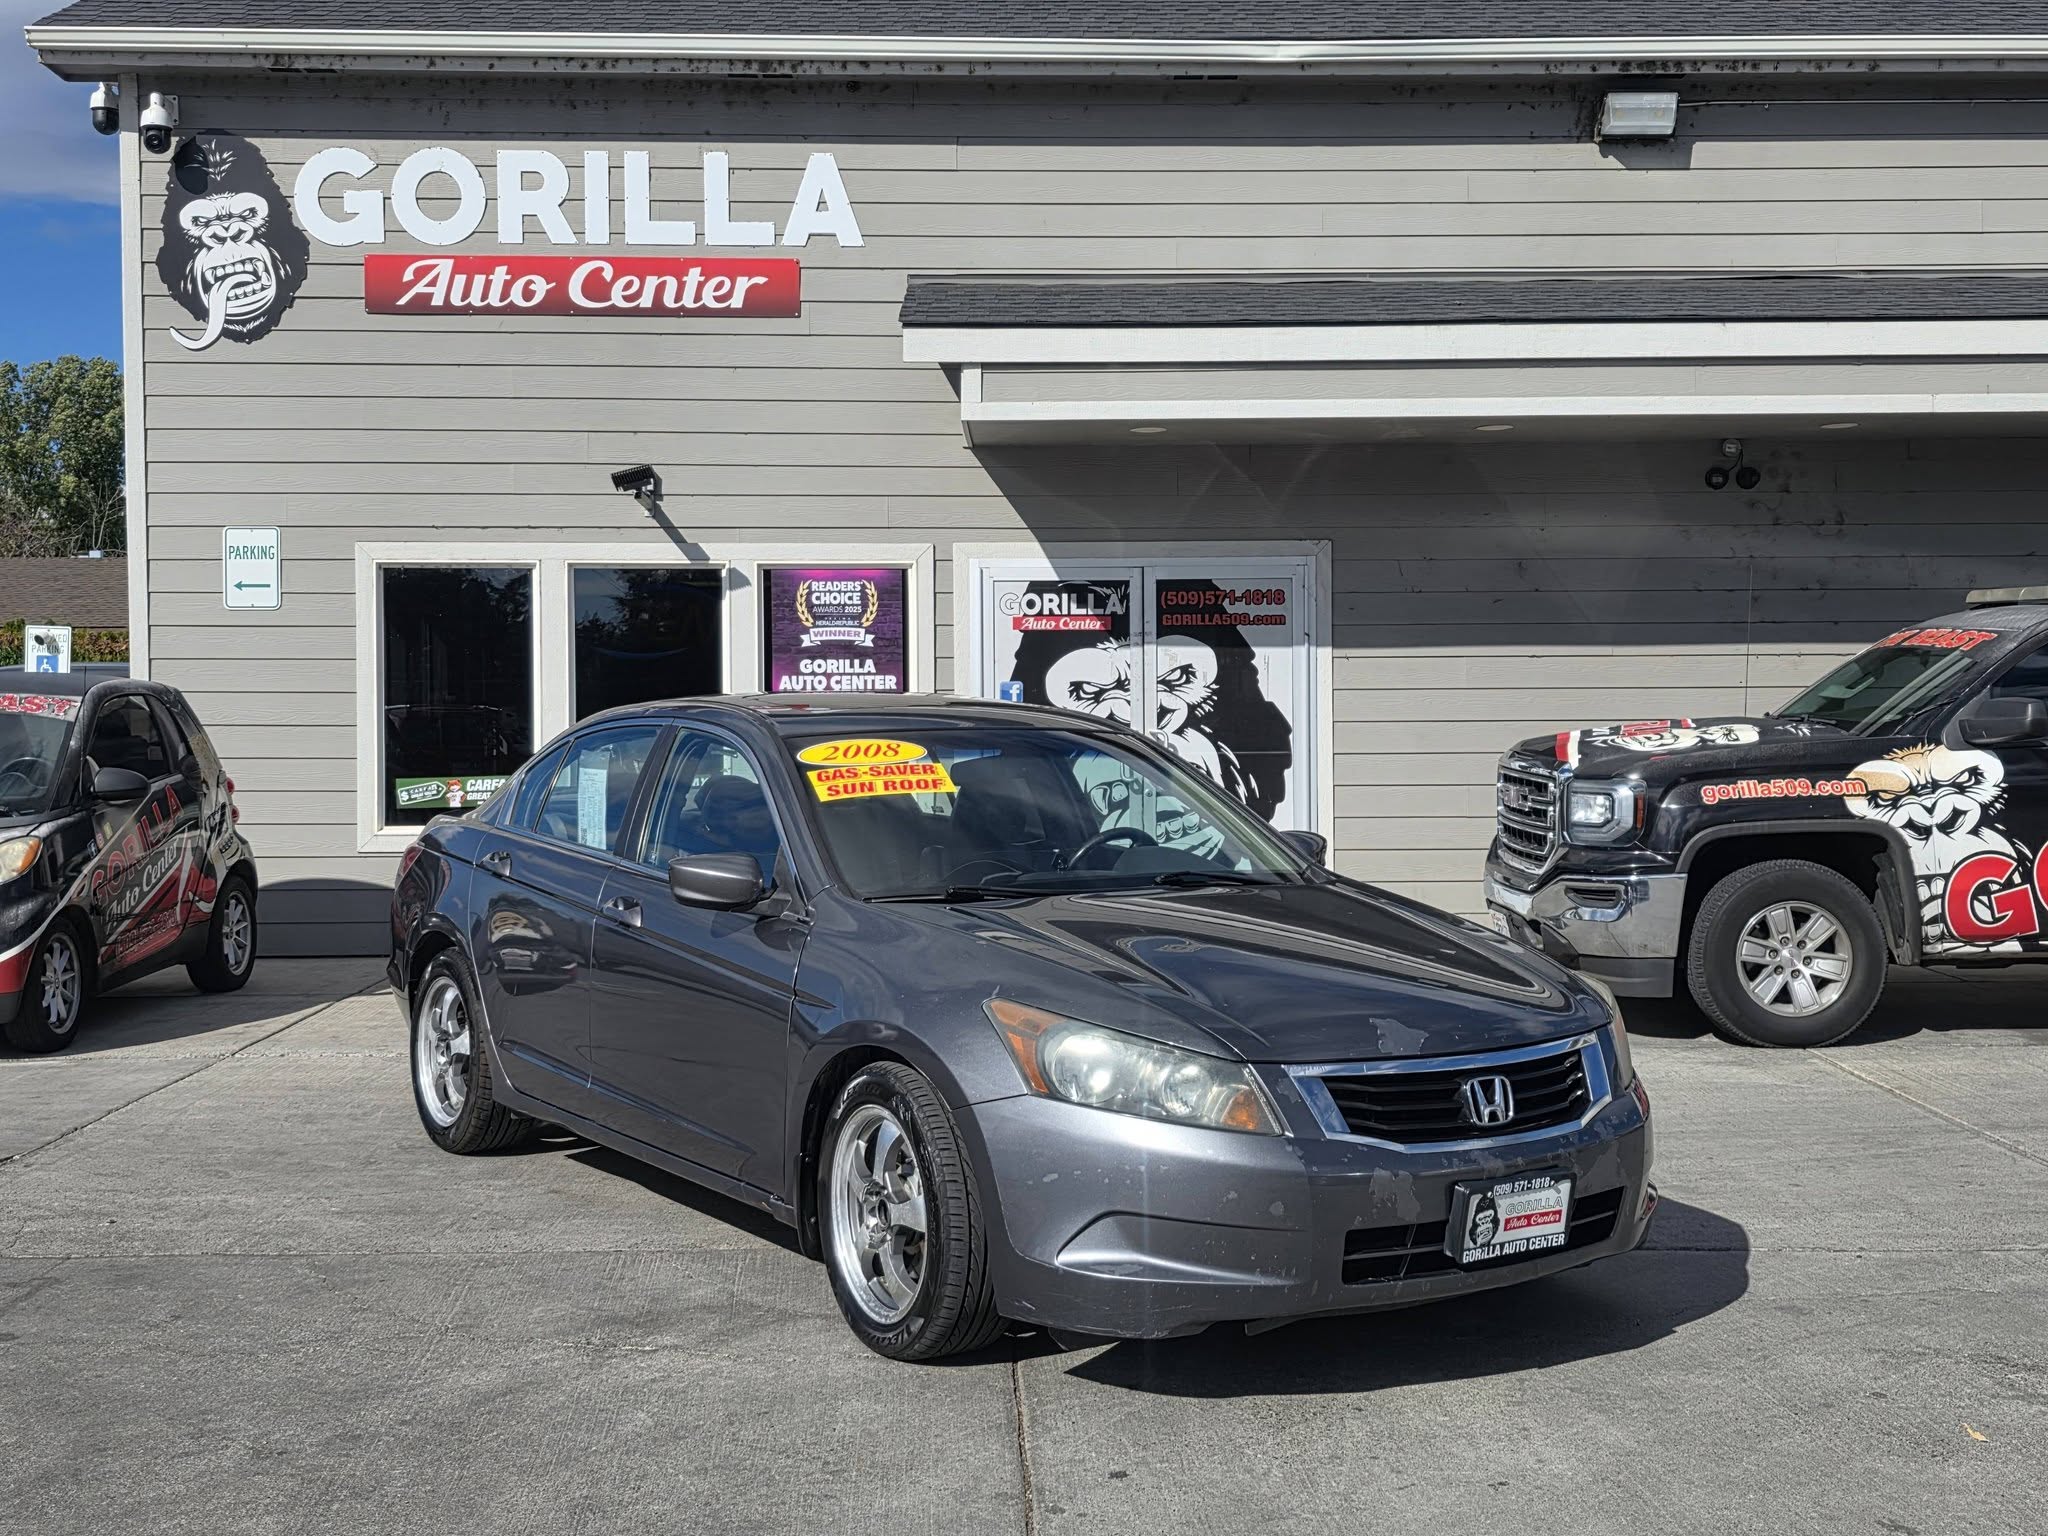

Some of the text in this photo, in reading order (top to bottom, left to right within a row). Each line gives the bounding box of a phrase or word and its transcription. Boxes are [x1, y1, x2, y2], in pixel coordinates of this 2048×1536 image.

[294, 146, 865, 247] GORILLA
[395, 258, 769, 309] Auto Center
[228, 545, 275, 560] PARKING
[811, 581, 863, 592] READERS'
[811, 592, 862, 605] CHOICE
[999, 592, 1124, 616] GORILLA
[1160, 589, 1286, 608] (509)571-1818
[812, 605, 862, 613] AWARDS 2025
[1021, 617, 1104, 630] Auto Center
[1162, 613, 1286, 626] GORILLA509.com
[812, 629, 861, 638] WINNER
[800, 659, 876, 673] GORILLA
[779, 675, 897, 690] AUTO CENTER
[821, 743, 901, 761] 2008
[816, 764, 936, 783] GAS-SAVER
[826, 778, 945, 797] SUN ROOF
[1701, 778, 1868, 805] gorilla509.com
[142, 842, 178, 893] Center
[1494, 1177, 1550, 1196] (509) 571-1818
[1506, 1196, 1563, 1215] GORILLA
[1506, 1213, 1560, 1230] Auto Center
[1463, 1233, 1565, 1263] GORILLA AUTO CENTER
